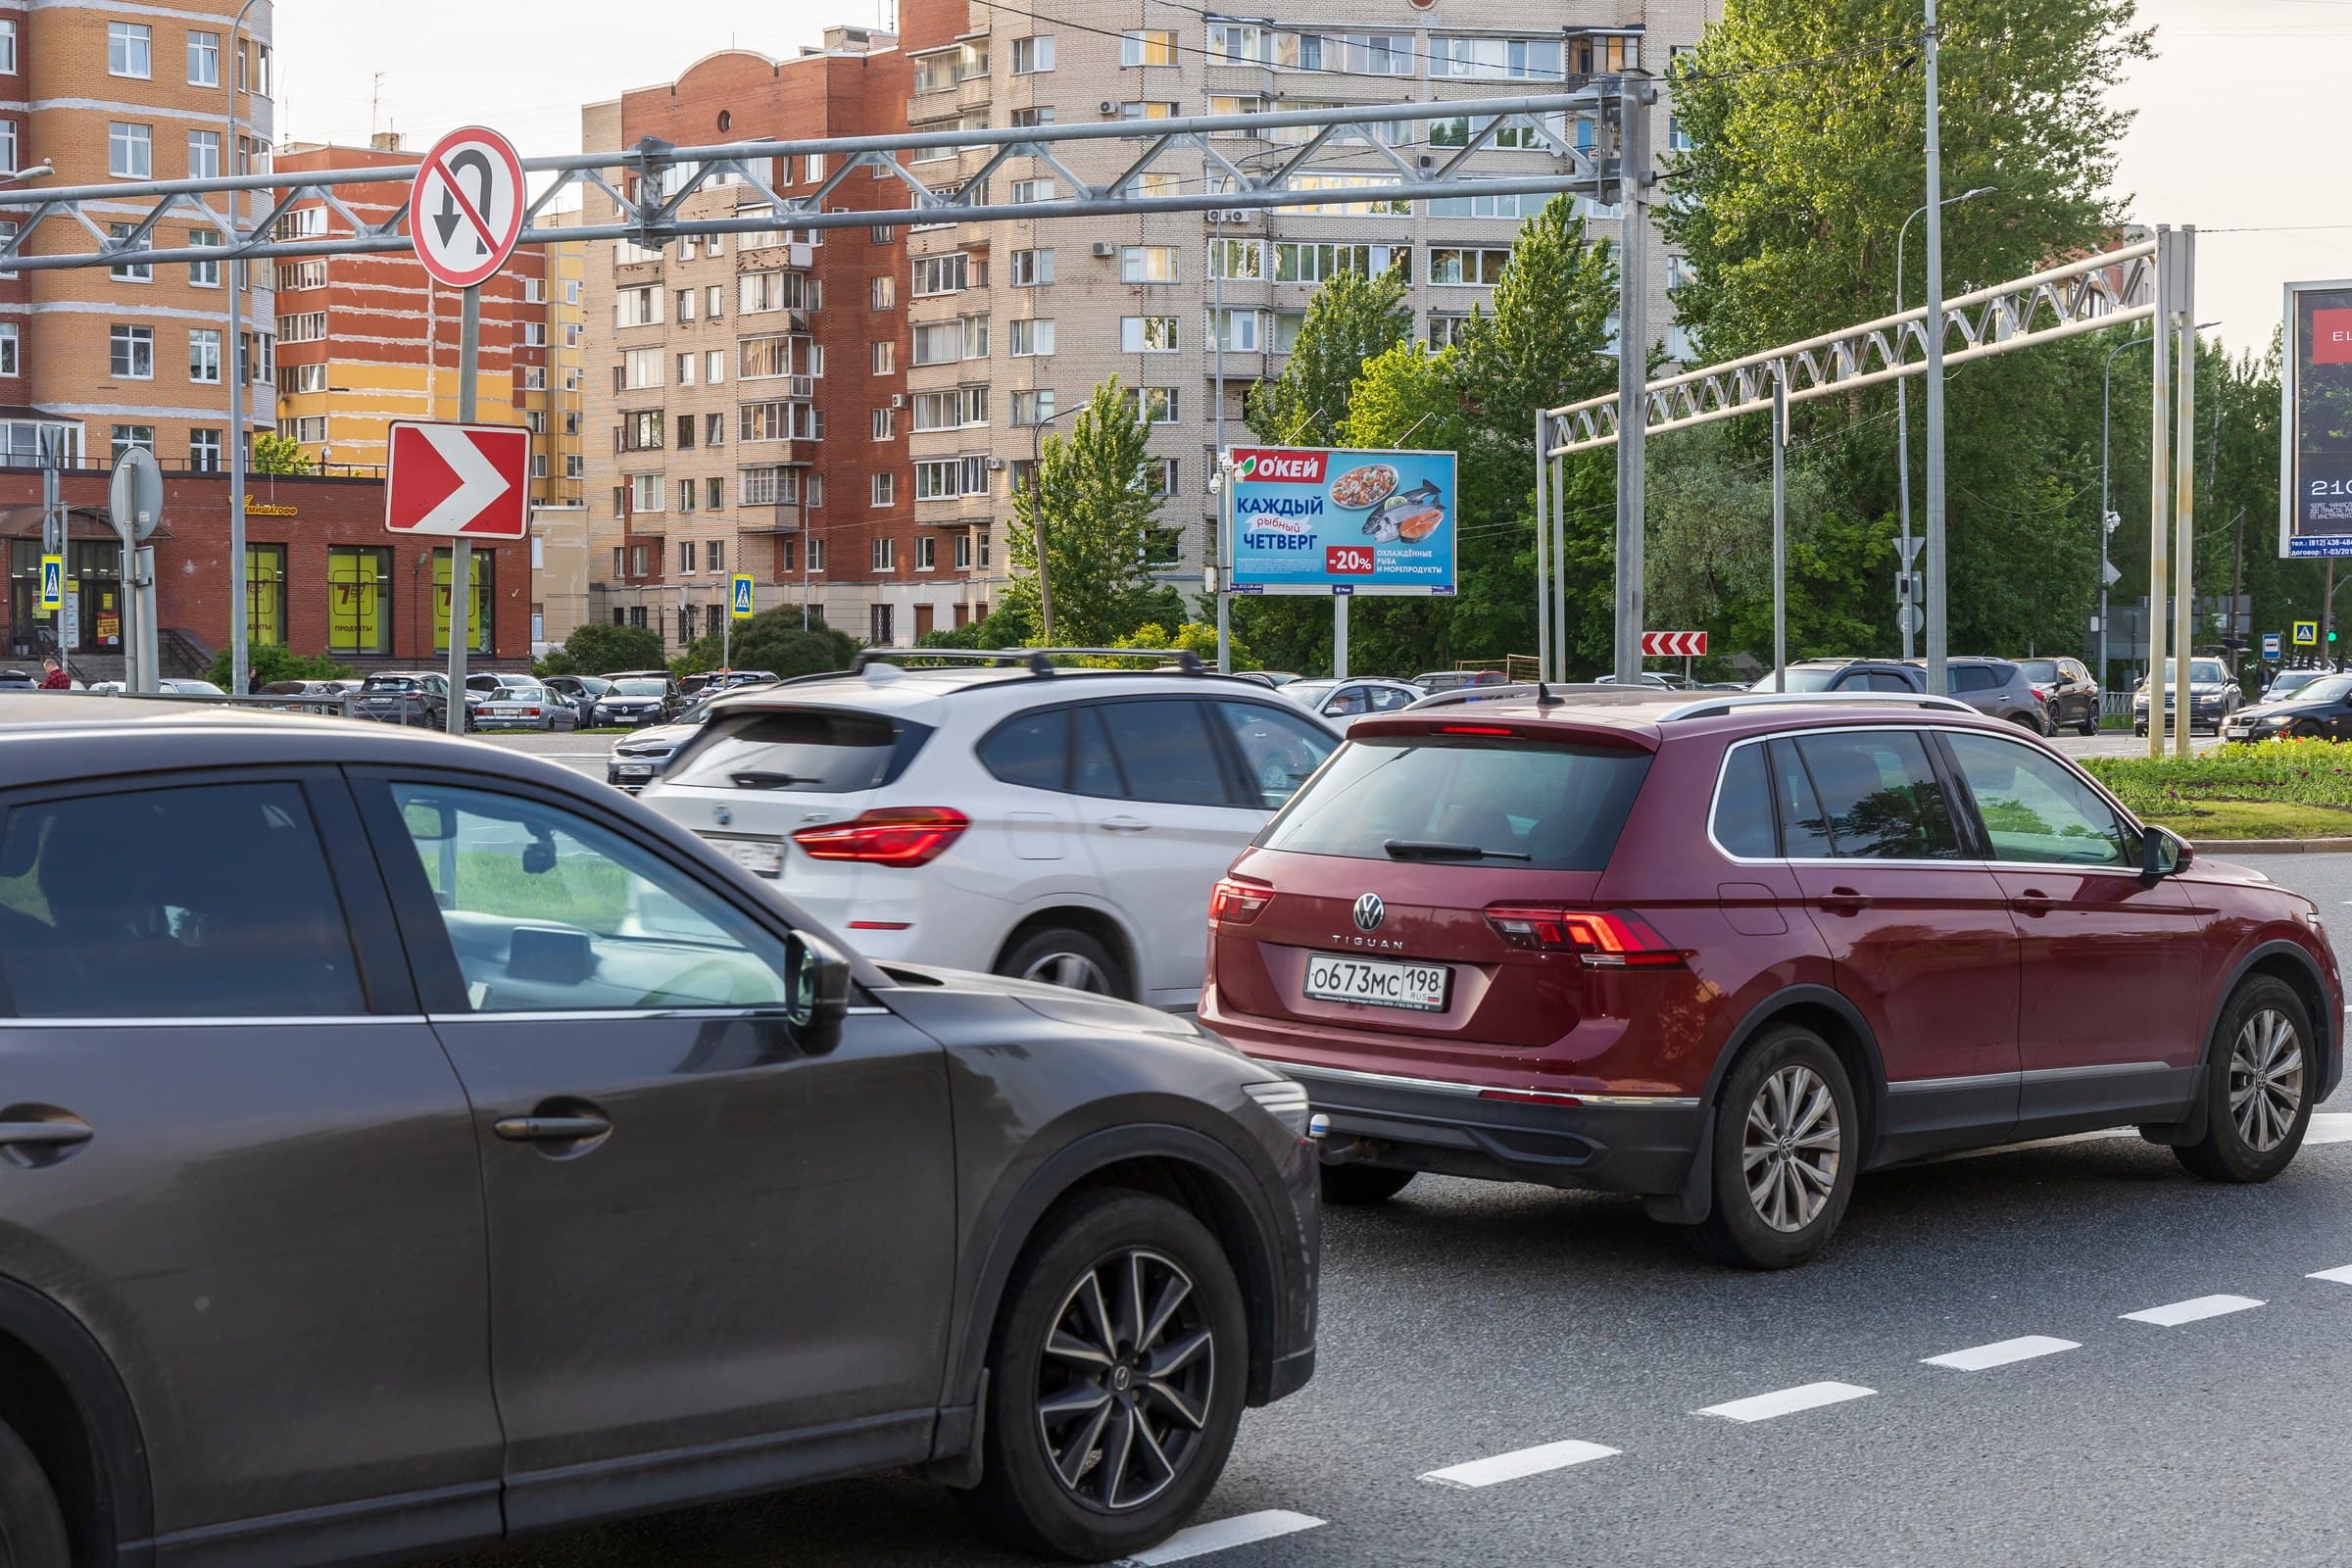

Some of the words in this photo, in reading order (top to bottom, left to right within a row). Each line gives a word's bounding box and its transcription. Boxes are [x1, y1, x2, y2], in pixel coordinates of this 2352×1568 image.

[1237, 496, 1324, 516] КАЖДЫЙ
[1256, 515, 1301, 533] рыбный
[1244, 533, 1318, 550] ЧЕТВЕРГ
[1329, 550, 1373, 570] -20%
[1376, 549, 1433, 558] ОХЛАЖДЁННЫЕ
[1383, 565, 1443, 574] МОРЕПРОДУКТЫ
[1333, 935, 1404, 949] TIGUAN
[1405, 969, 1440, 992] 198
[1410, 992, 1427, 1001] RUS
